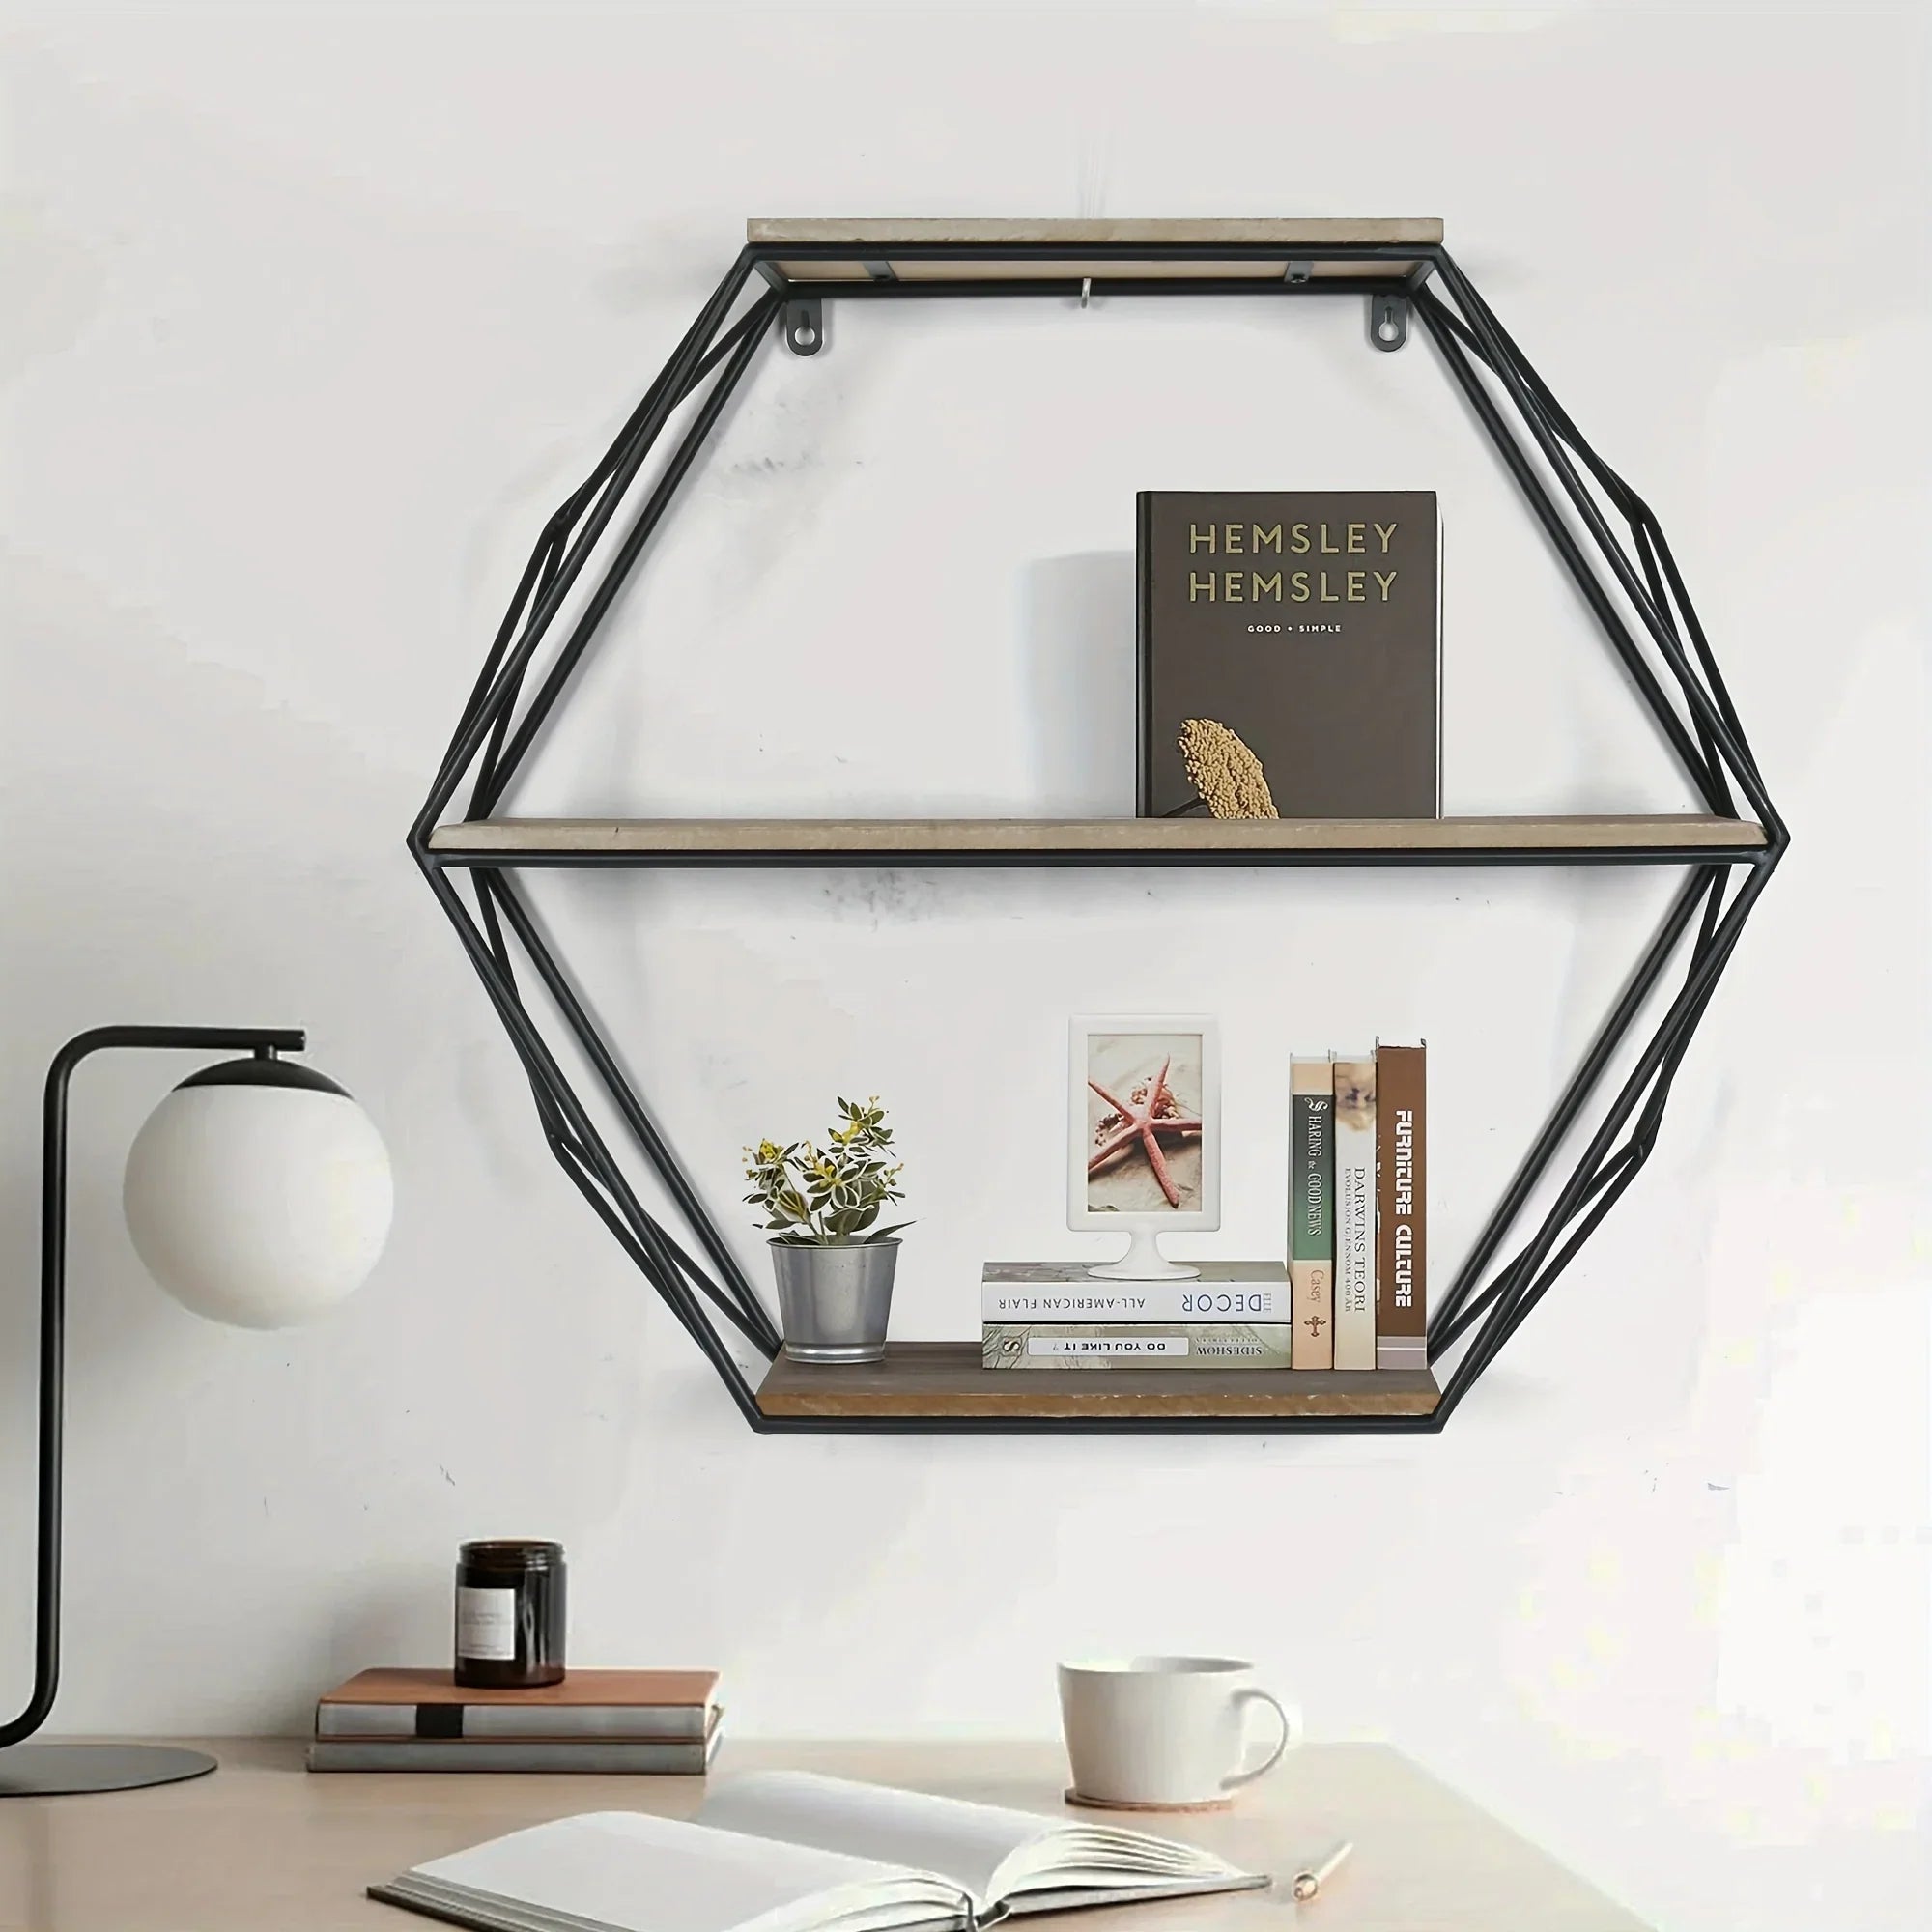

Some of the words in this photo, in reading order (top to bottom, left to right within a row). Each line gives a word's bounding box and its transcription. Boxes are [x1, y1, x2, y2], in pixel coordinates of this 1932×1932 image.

[1189, 523, 1398, 554] HEMSLEY
[1189, 571, 1398, 602] HEMSLEY
[1247, 624, 1282, 633] GOOD
[1298, 624, 1342, 633] SIMPLE
[1307, 1173, 1322, 1204] GOOD
[1354, 1167, 1366, 1252] DARWINS
[1307, 1205, 1322, 1236] NEWS
[1395, 1224, 1413, 1308] CULTURE
[1307, 1269, 1324, 1303] Casey
[1354, 1257, 1366, 1312] TEORI
[999, 1298, 1037, 1310] FLAIR
[1043, 1298, 1146, 1310] ALL-AMERICAN
[1181, 1293, 1262, 1312] DECOR
[1064, 1342, 1076, 1350] IT
[1081, 1342, 1112, 1350] LIKE
[1115, 1342, 1142, 1350] YOU
[1147, 1342, 1166, 1350] DO
[1197, 1346, 1263, 1355] SIDESHOW
